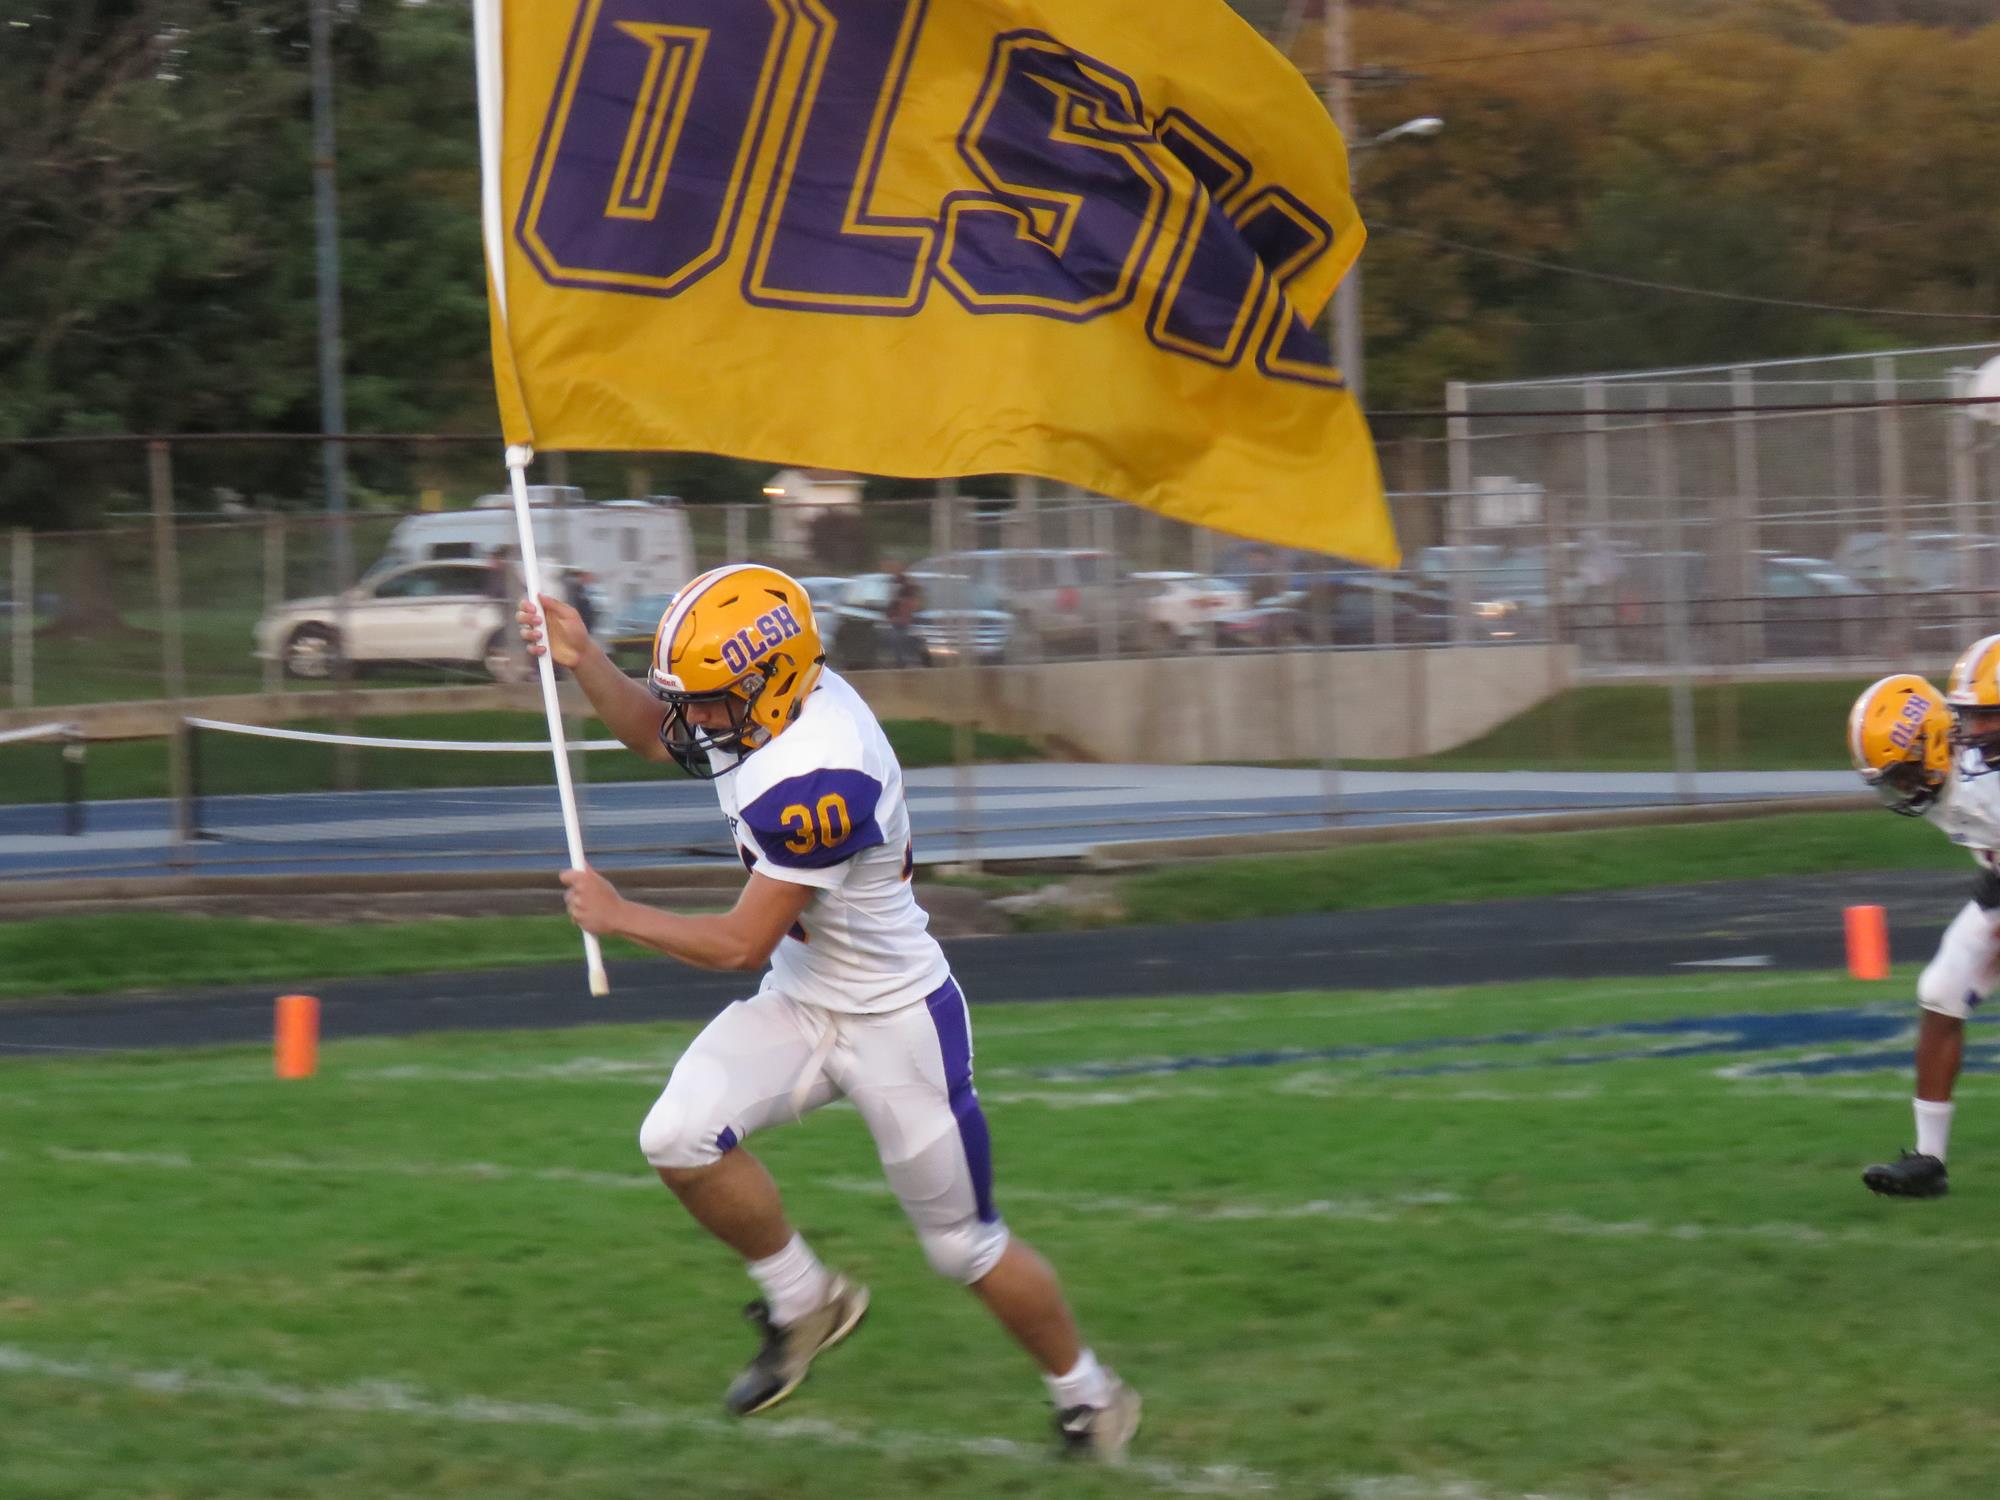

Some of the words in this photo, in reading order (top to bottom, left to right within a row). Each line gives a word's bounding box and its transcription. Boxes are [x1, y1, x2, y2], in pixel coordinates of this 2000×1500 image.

[721, 604, 802, 675] OLSH
[1889, 694, 1931, 748] OLSH
[780, 792, 851, 855] 30
